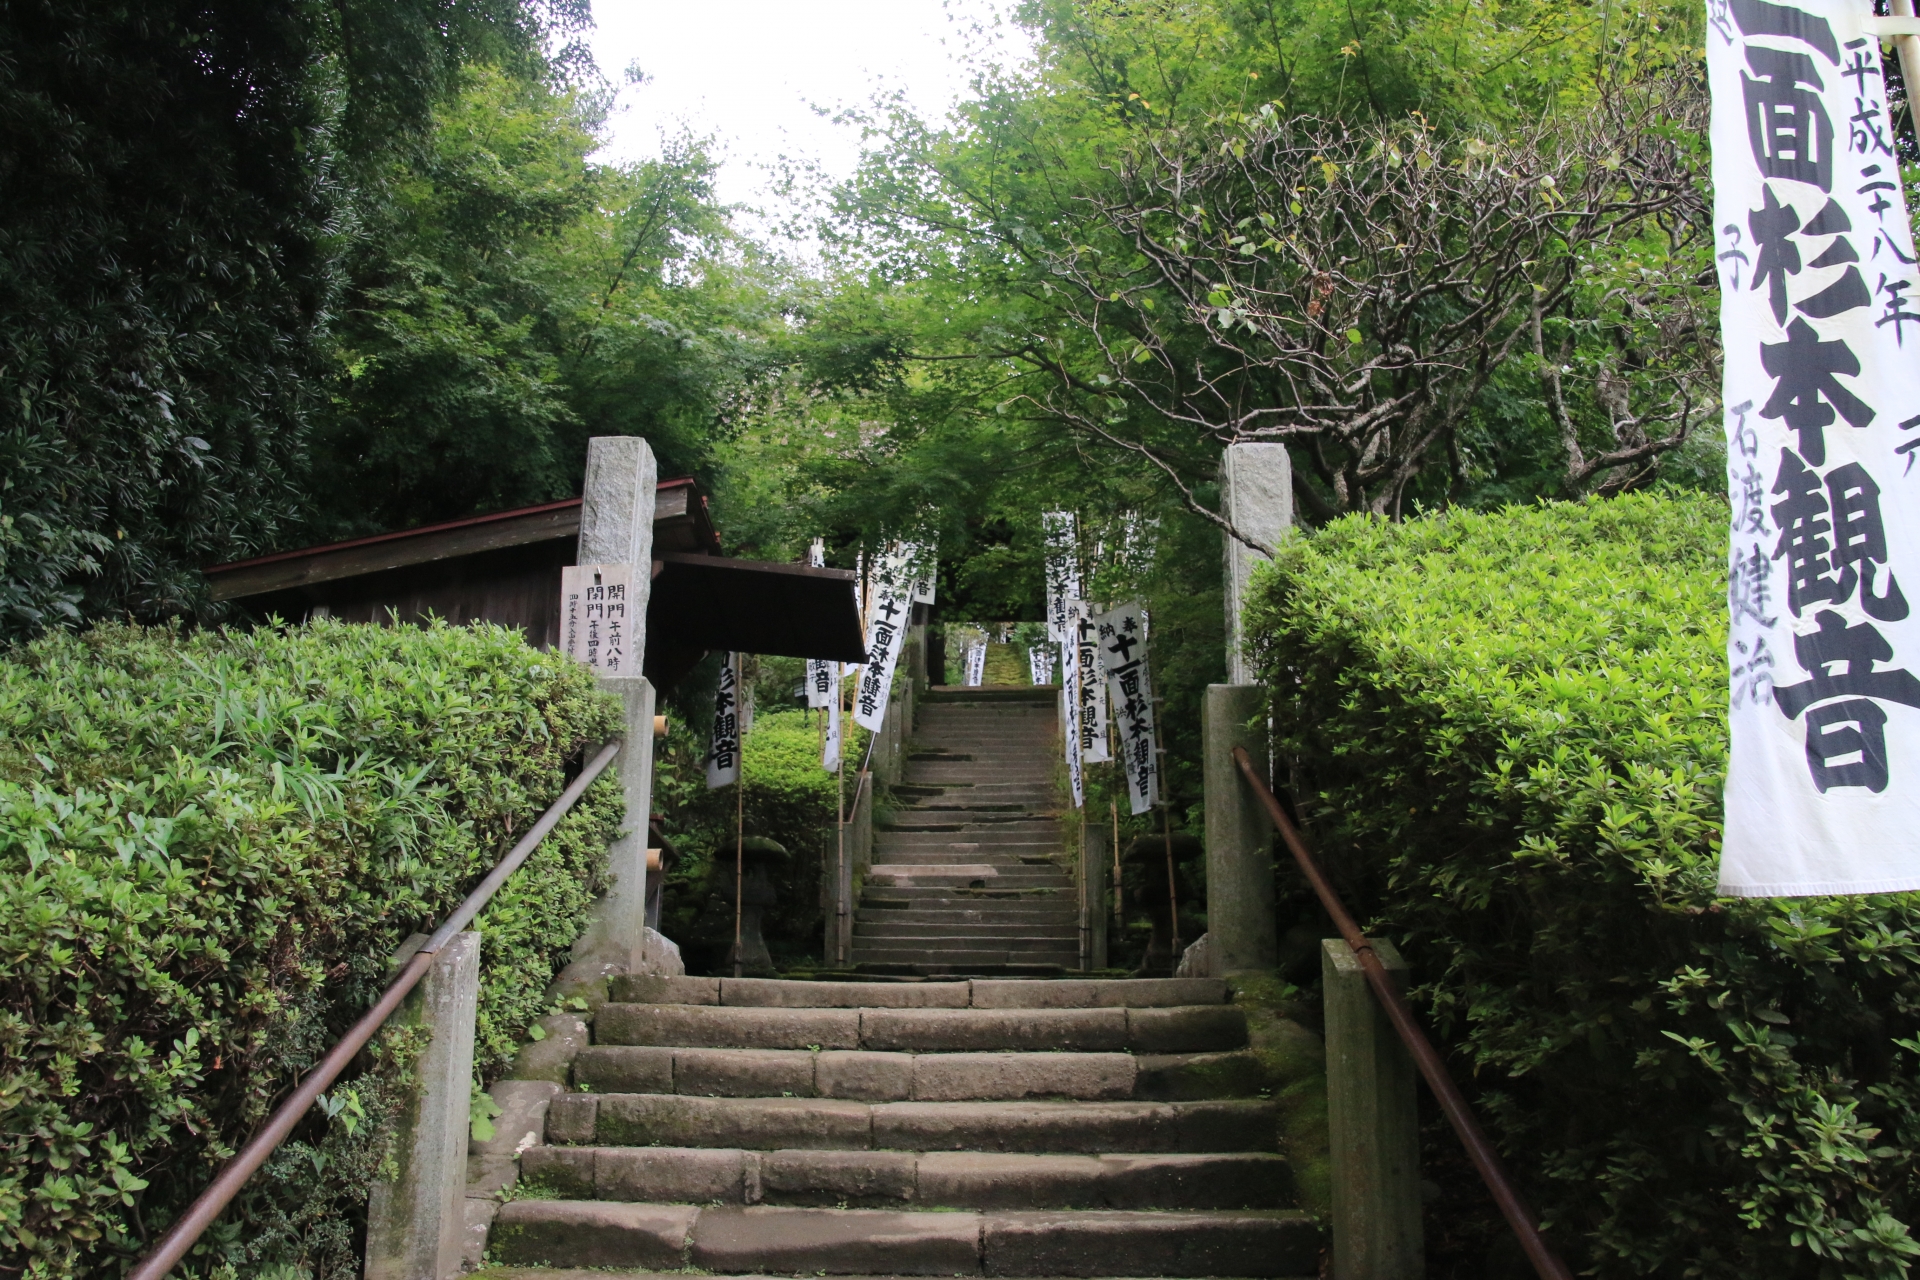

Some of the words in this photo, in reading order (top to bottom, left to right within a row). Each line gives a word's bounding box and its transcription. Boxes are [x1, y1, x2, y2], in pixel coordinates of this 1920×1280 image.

[1841, 36, 1920, 349] 平成二十八年
